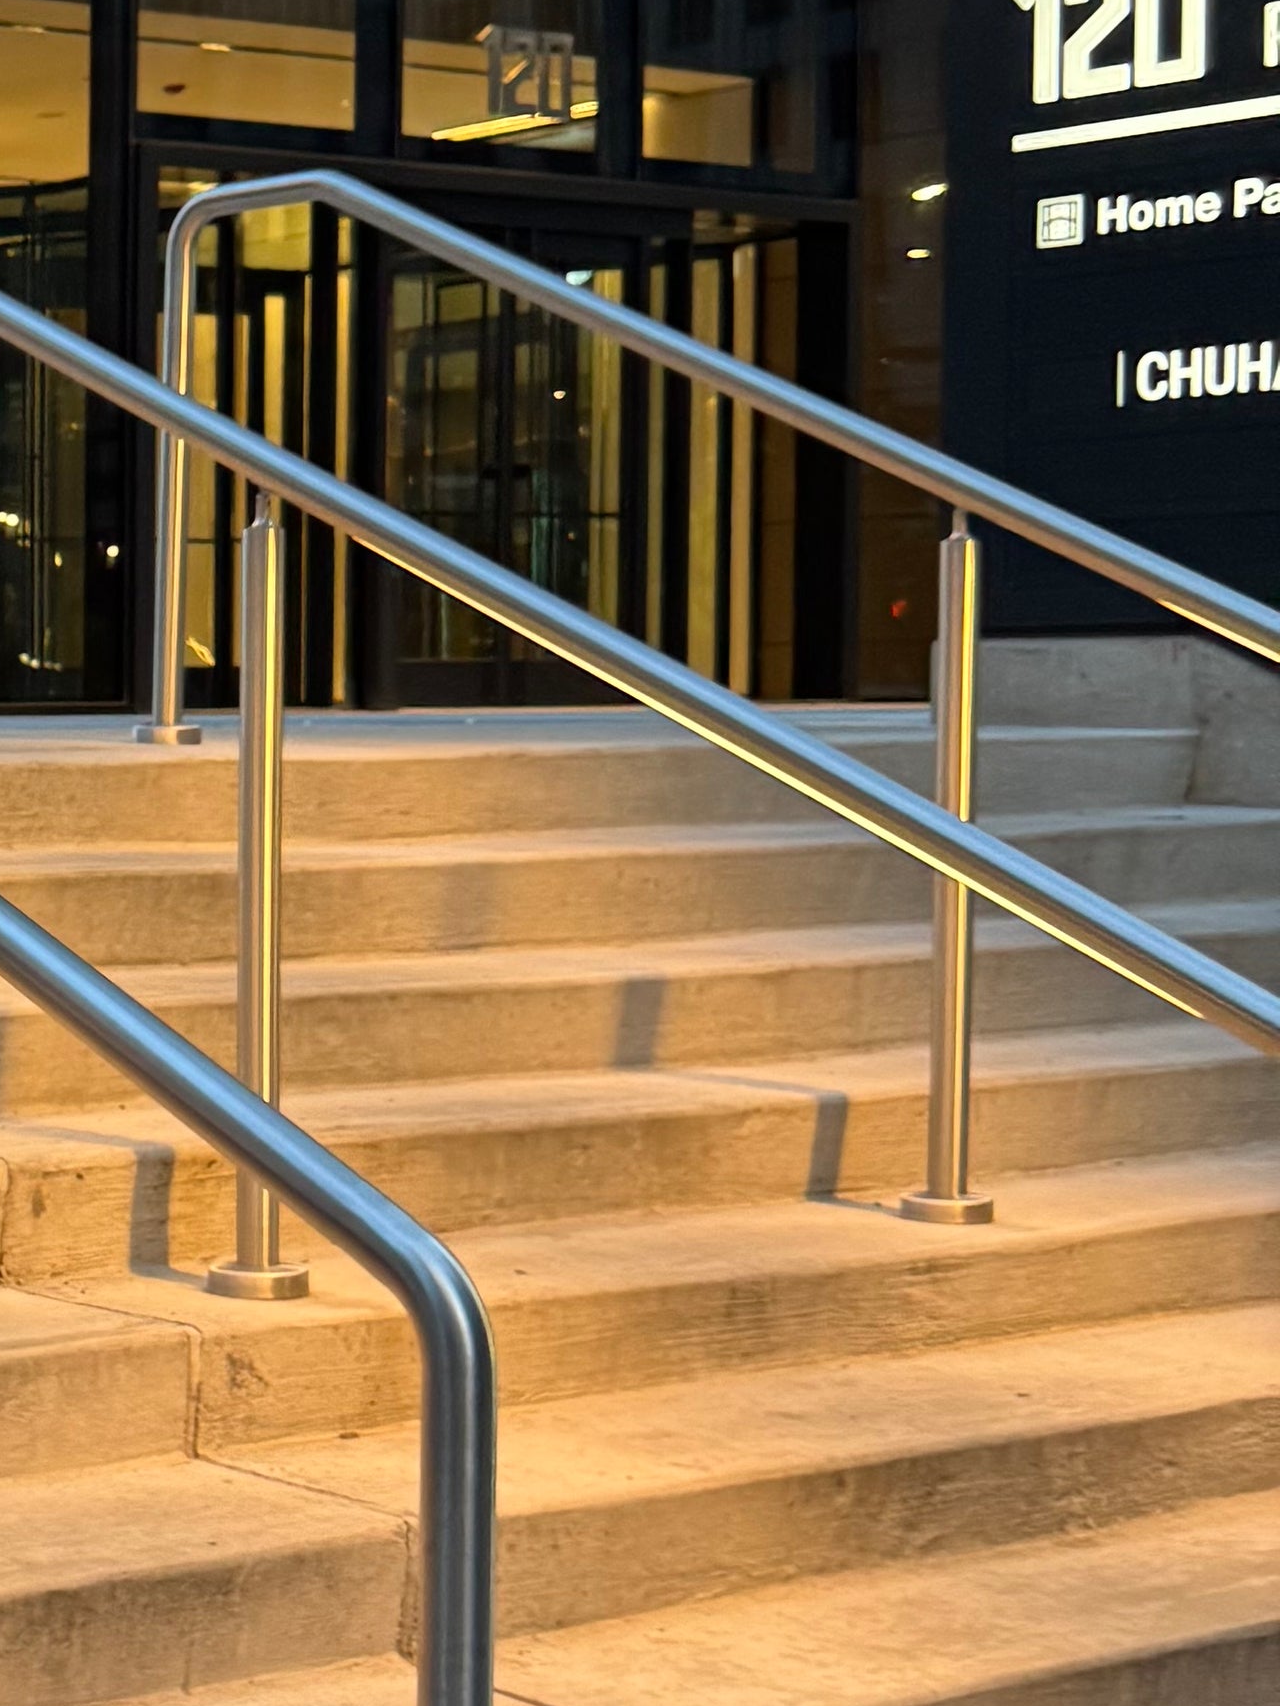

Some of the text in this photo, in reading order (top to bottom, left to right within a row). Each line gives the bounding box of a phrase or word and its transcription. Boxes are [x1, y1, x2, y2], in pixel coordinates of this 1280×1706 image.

[474, 23, 574, 121] 120
[1096, 191, 1222, 236] Home
[1136, 340, 1280, 402] CHUH
